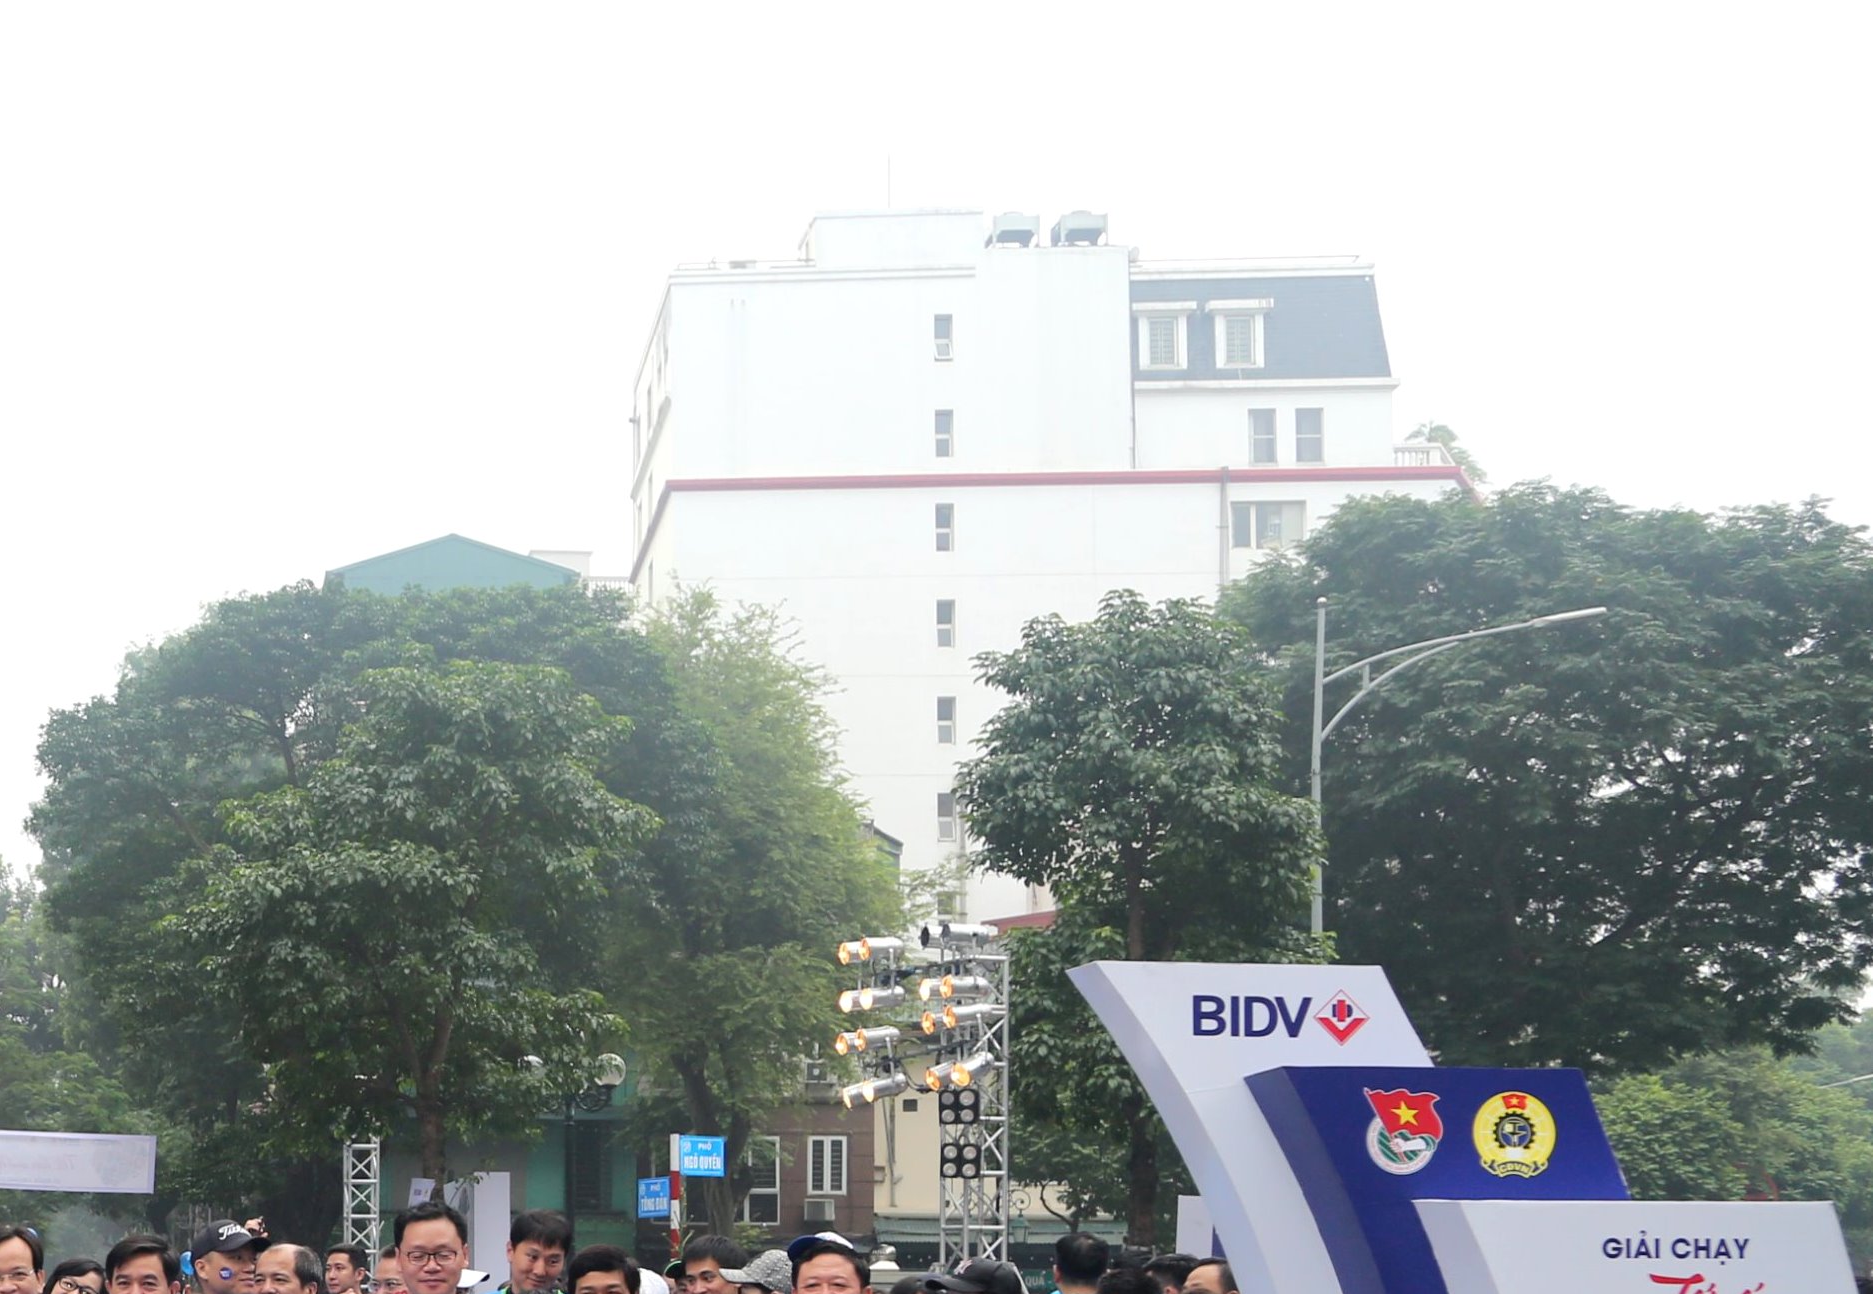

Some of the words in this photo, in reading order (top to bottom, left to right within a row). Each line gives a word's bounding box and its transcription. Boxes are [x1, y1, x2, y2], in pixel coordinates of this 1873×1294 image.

[1192, 995, 1314, 1038] BIDV
[1602, 1230, 1661, 1259] GIẢI
[1671, 1237, 1749, 1265] CHẠY
